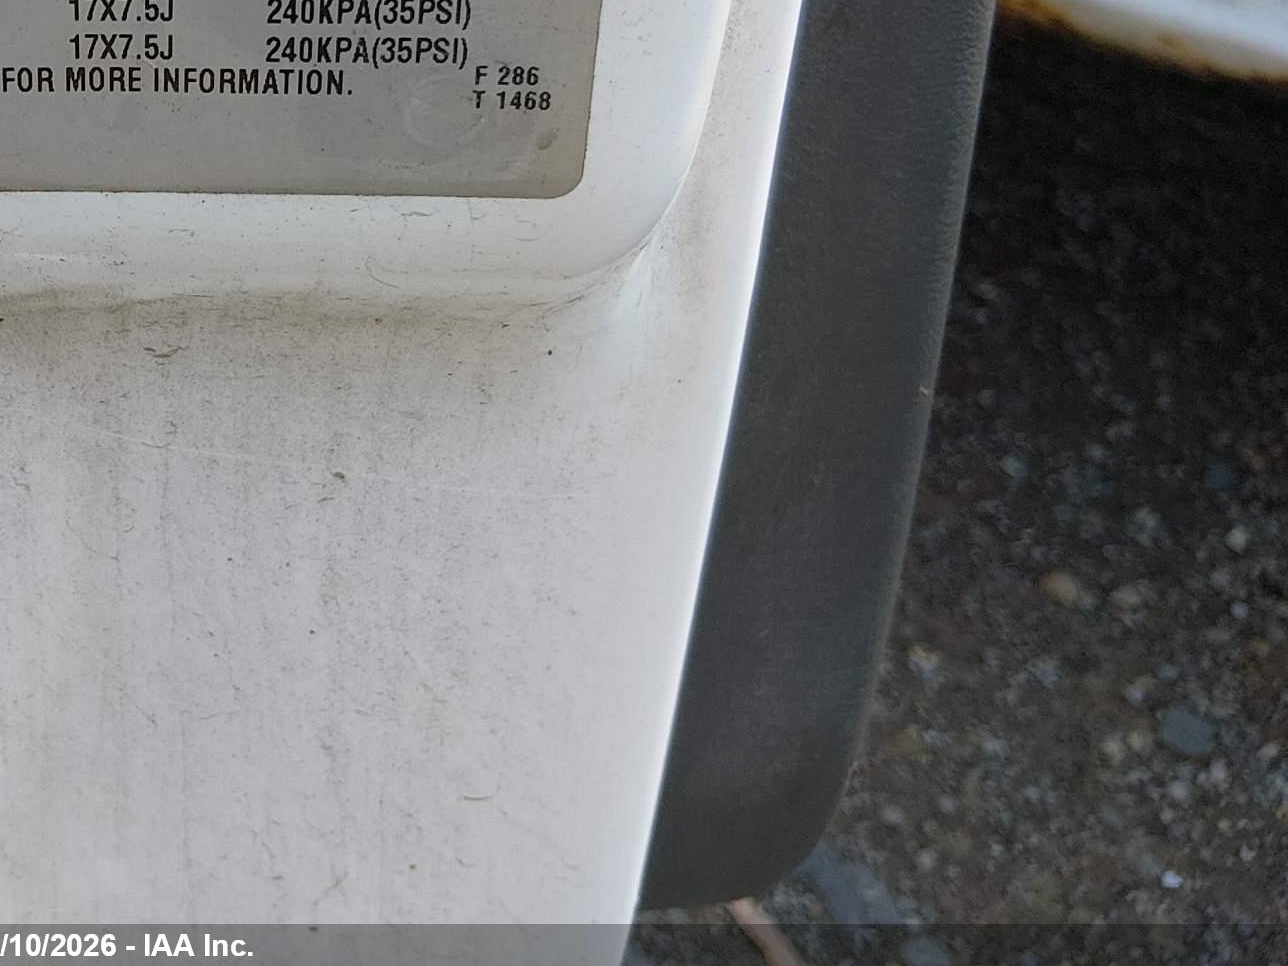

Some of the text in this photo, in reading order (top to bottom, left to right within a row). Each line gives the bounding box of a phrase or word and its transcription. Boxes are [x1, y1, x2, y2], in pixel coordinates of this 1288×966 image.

[70, 34, 172, 60] 17X7.5J
[266, 37, 467, 69] 240KPA(35PSI)
[3, 67, 54, 92] FOR
[66, 67, 141, 91] MORE
[154, 68, 352, 95] INFORMATION.
[475, 66, 539, 85] F 286
[472, 90, 551, 110] T 1468
